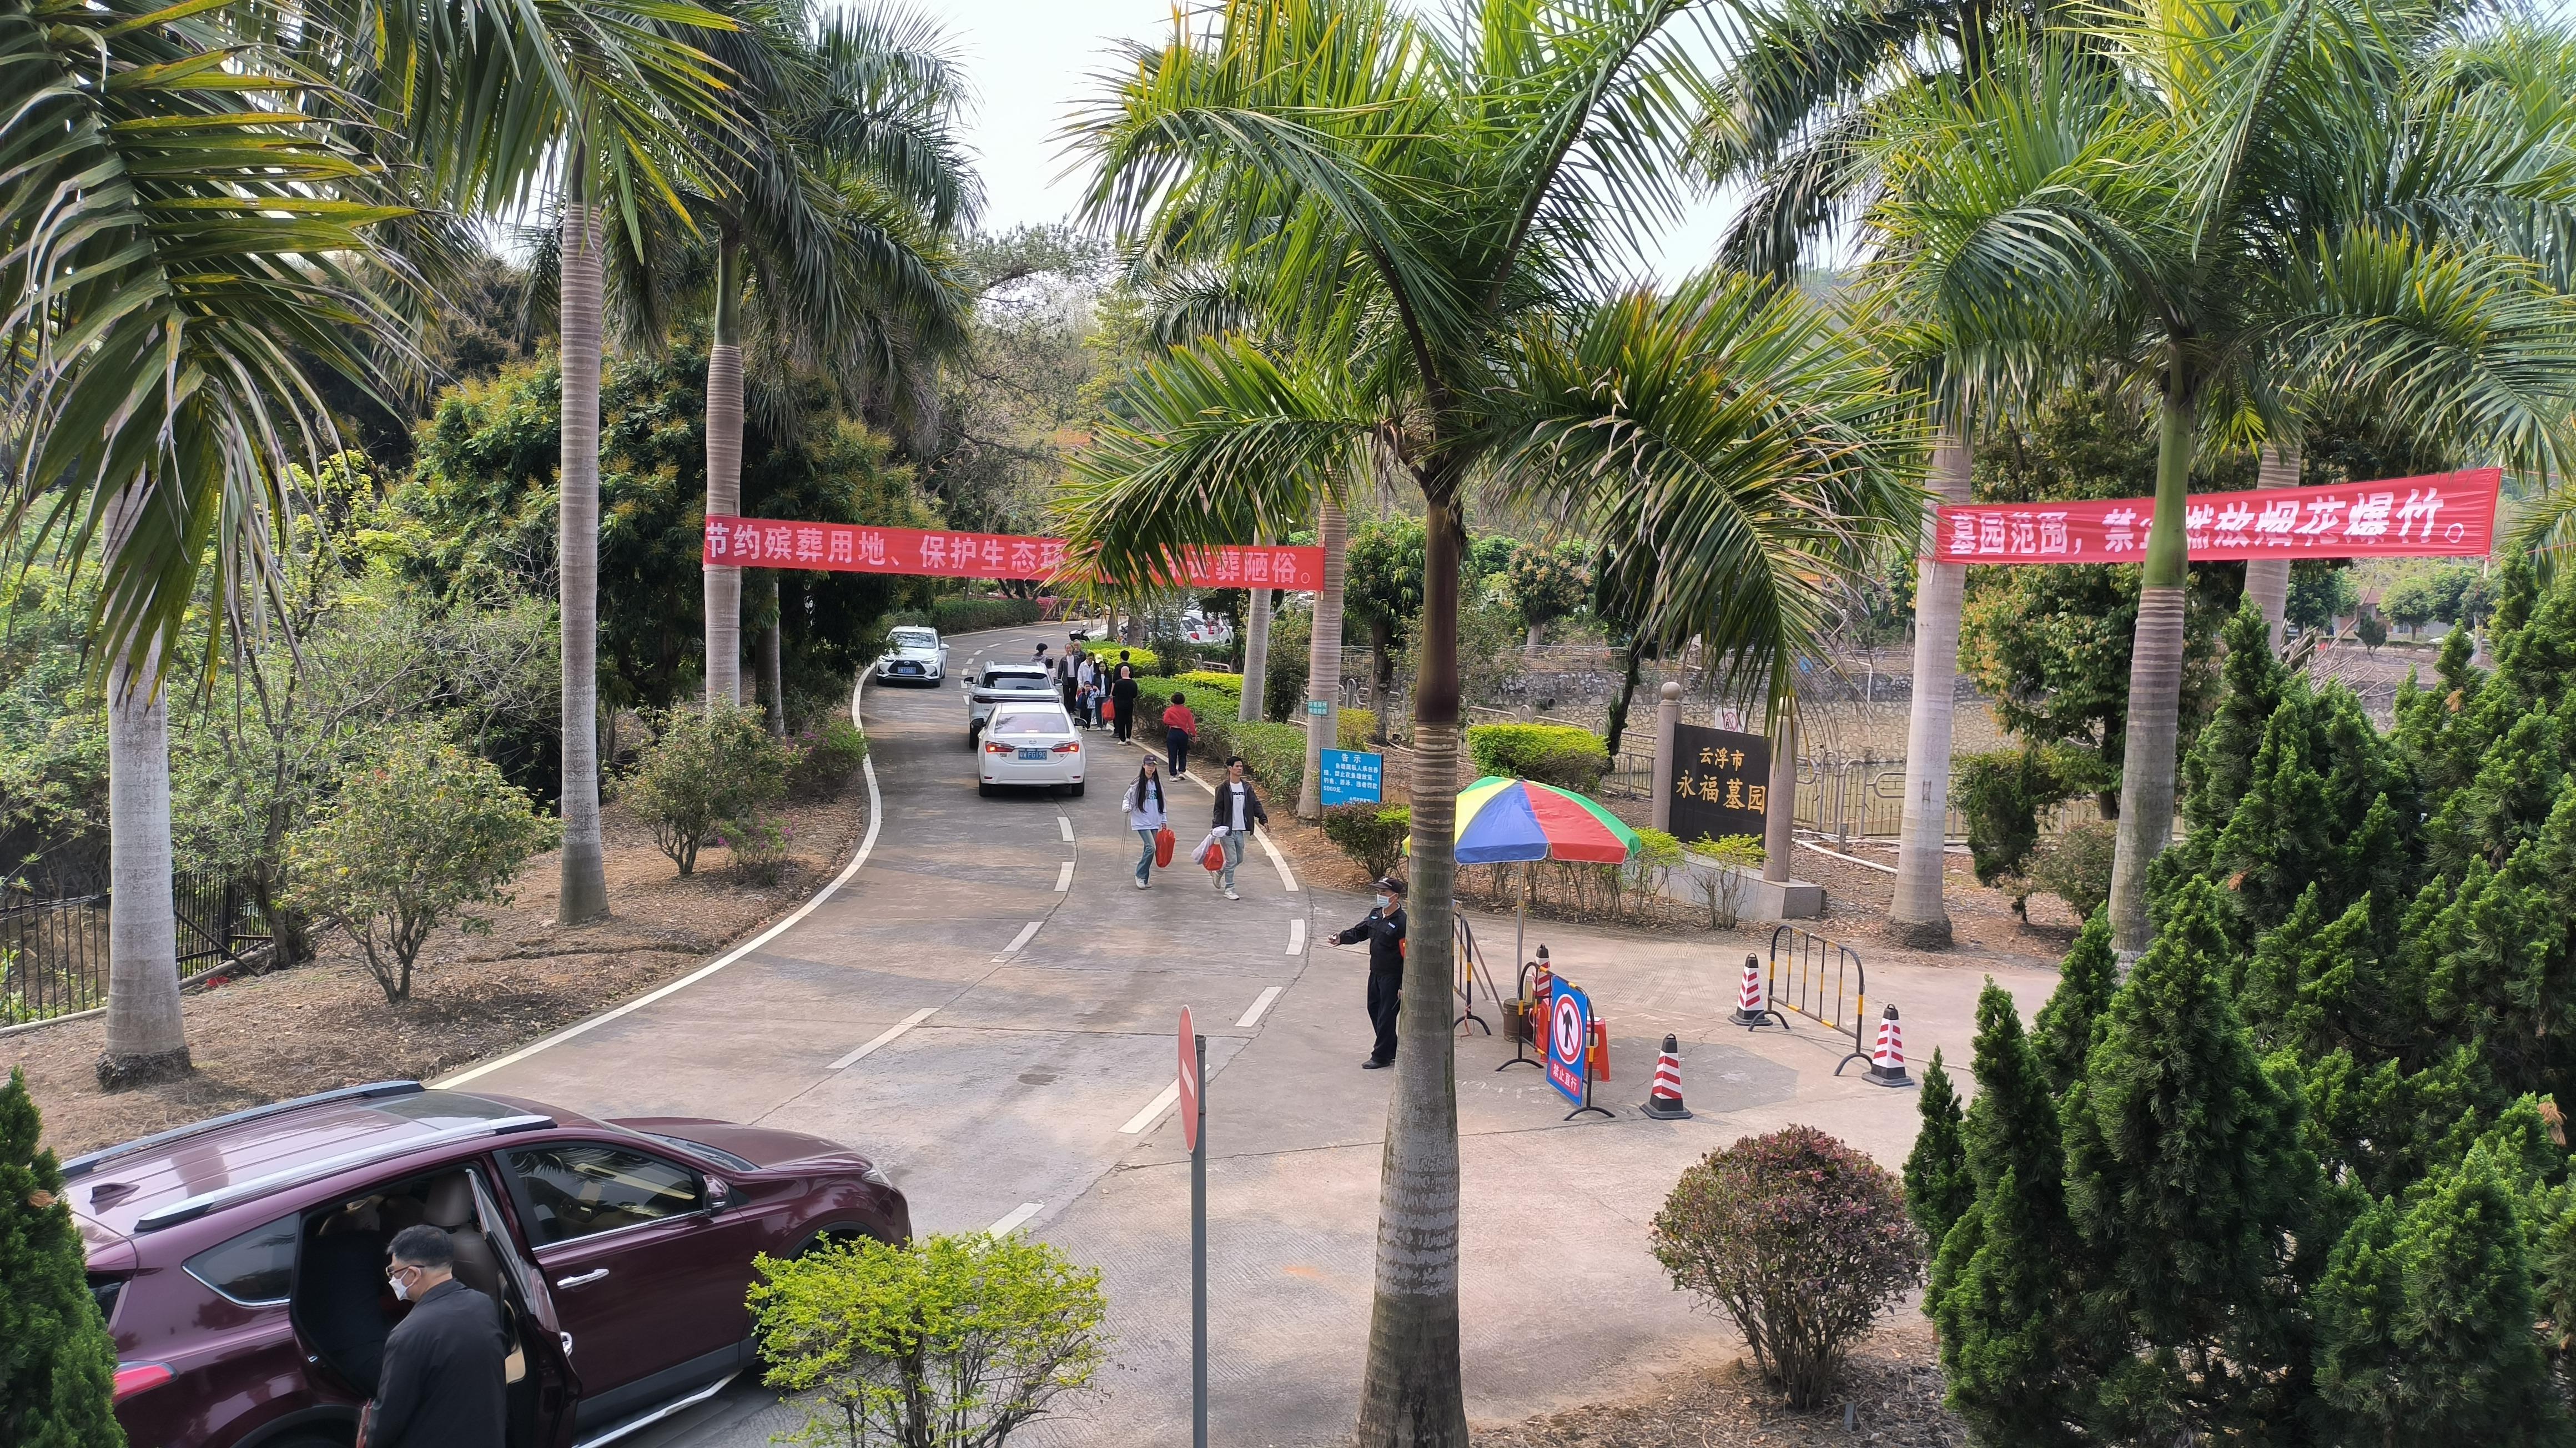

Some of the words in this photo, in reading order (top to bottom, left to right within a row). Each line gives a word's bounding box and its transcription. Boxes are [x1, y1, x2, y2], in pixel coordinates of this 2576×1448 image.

[1699, 747, 1745, 772] 云浮市
[1676, 769, 1766, 815] 永福墓园
[1553, 1063, 1577, 1092] 禁止直行
